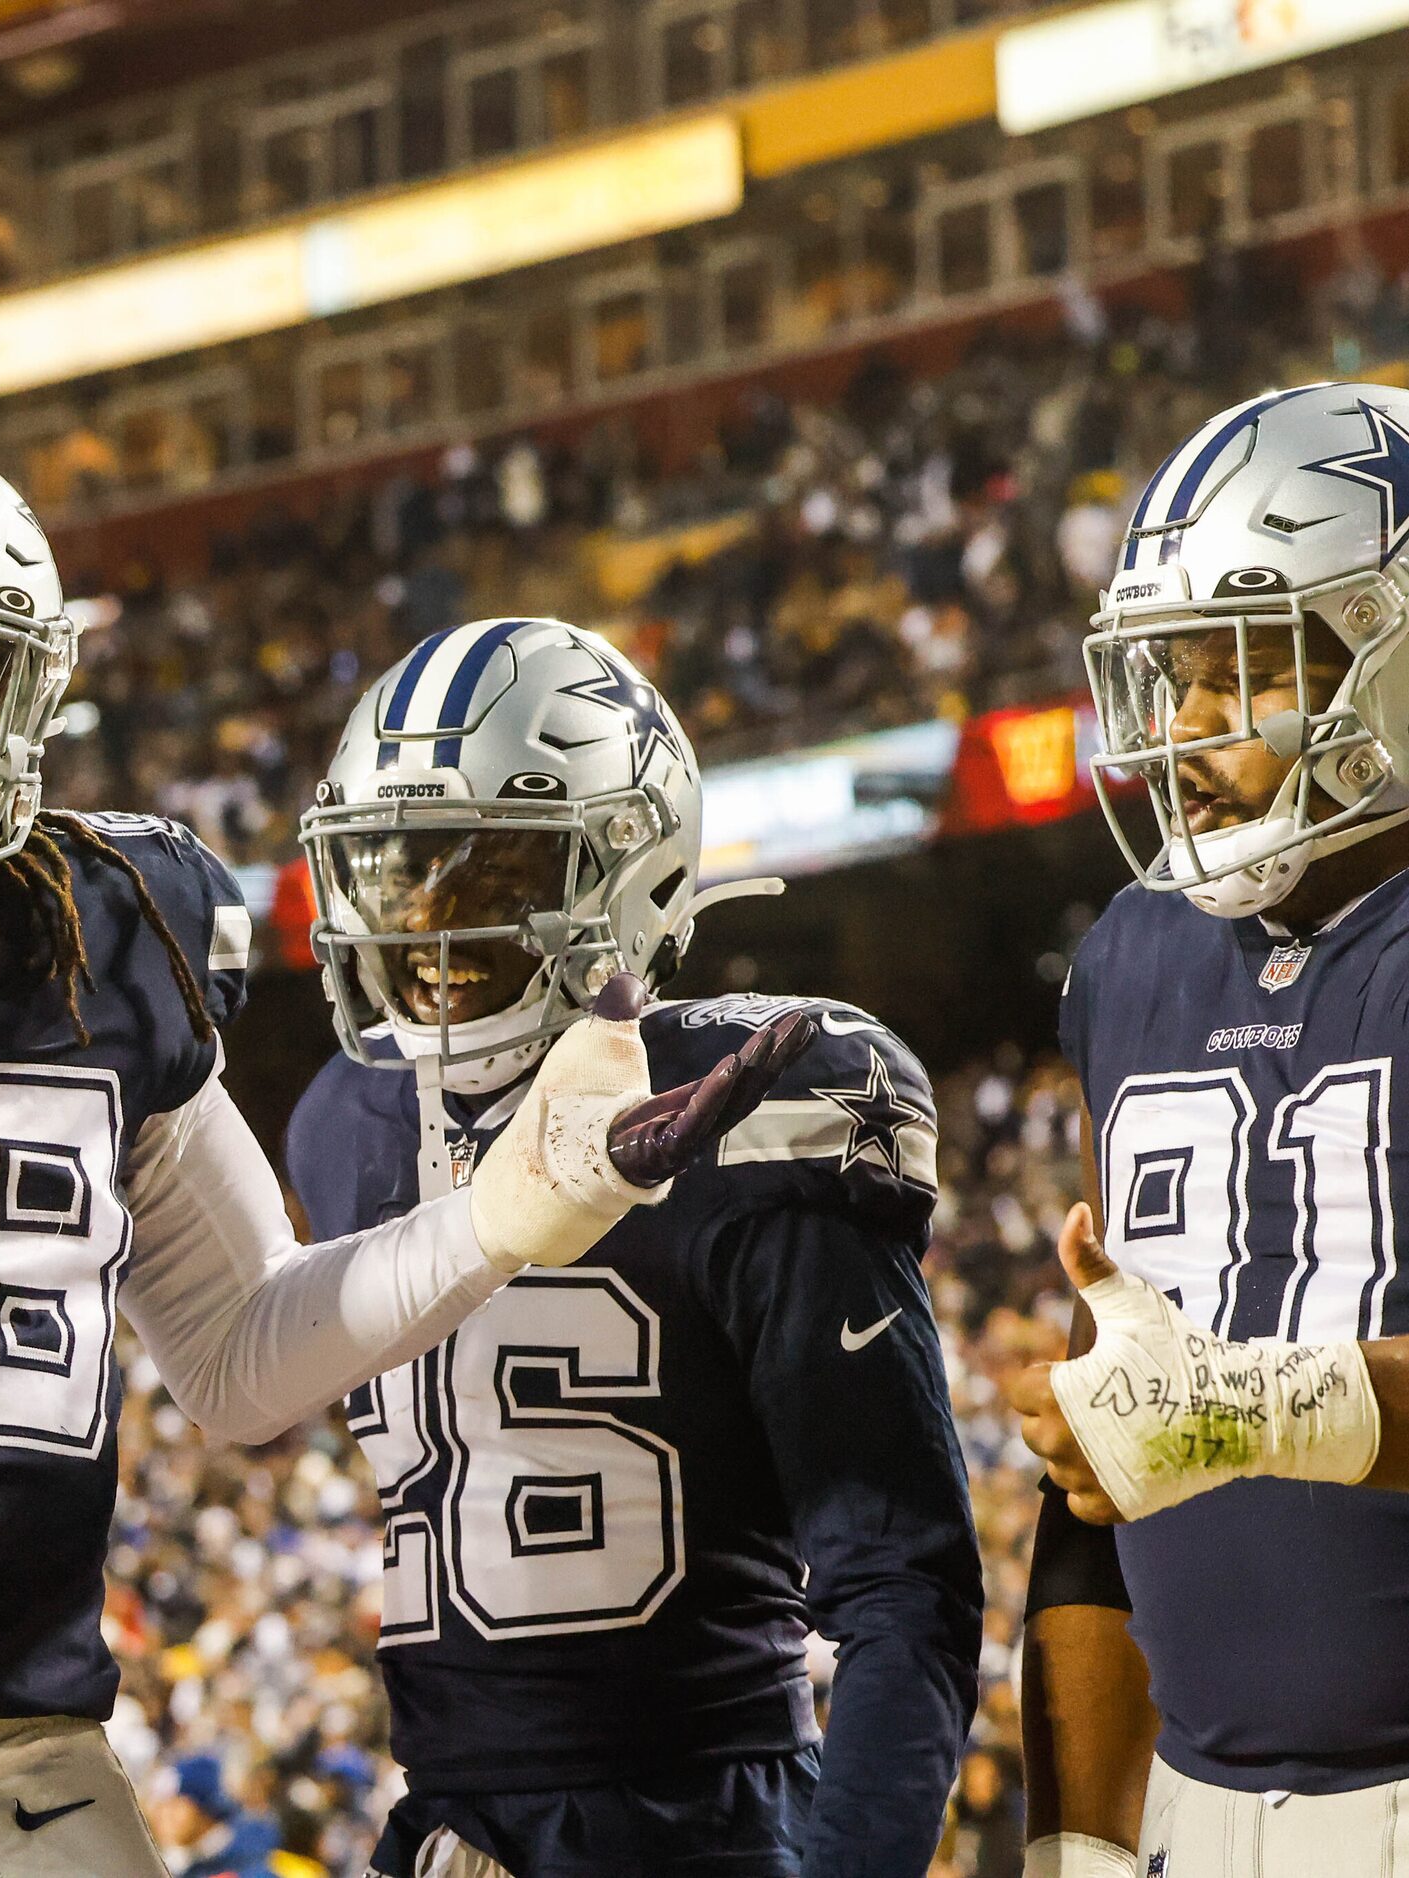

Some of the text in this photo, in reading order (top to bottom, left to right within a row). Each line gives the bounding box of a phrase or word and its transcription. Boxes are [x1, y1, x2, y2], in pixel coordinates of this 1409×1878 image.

[1116, 582, 1162, 603] COWBOYS
[377, 783, 445, 799] COWBOYS
[1205, 1022, 1304, 1053] COWBOYS
[1100, 1056, 1398, 1344] 91
